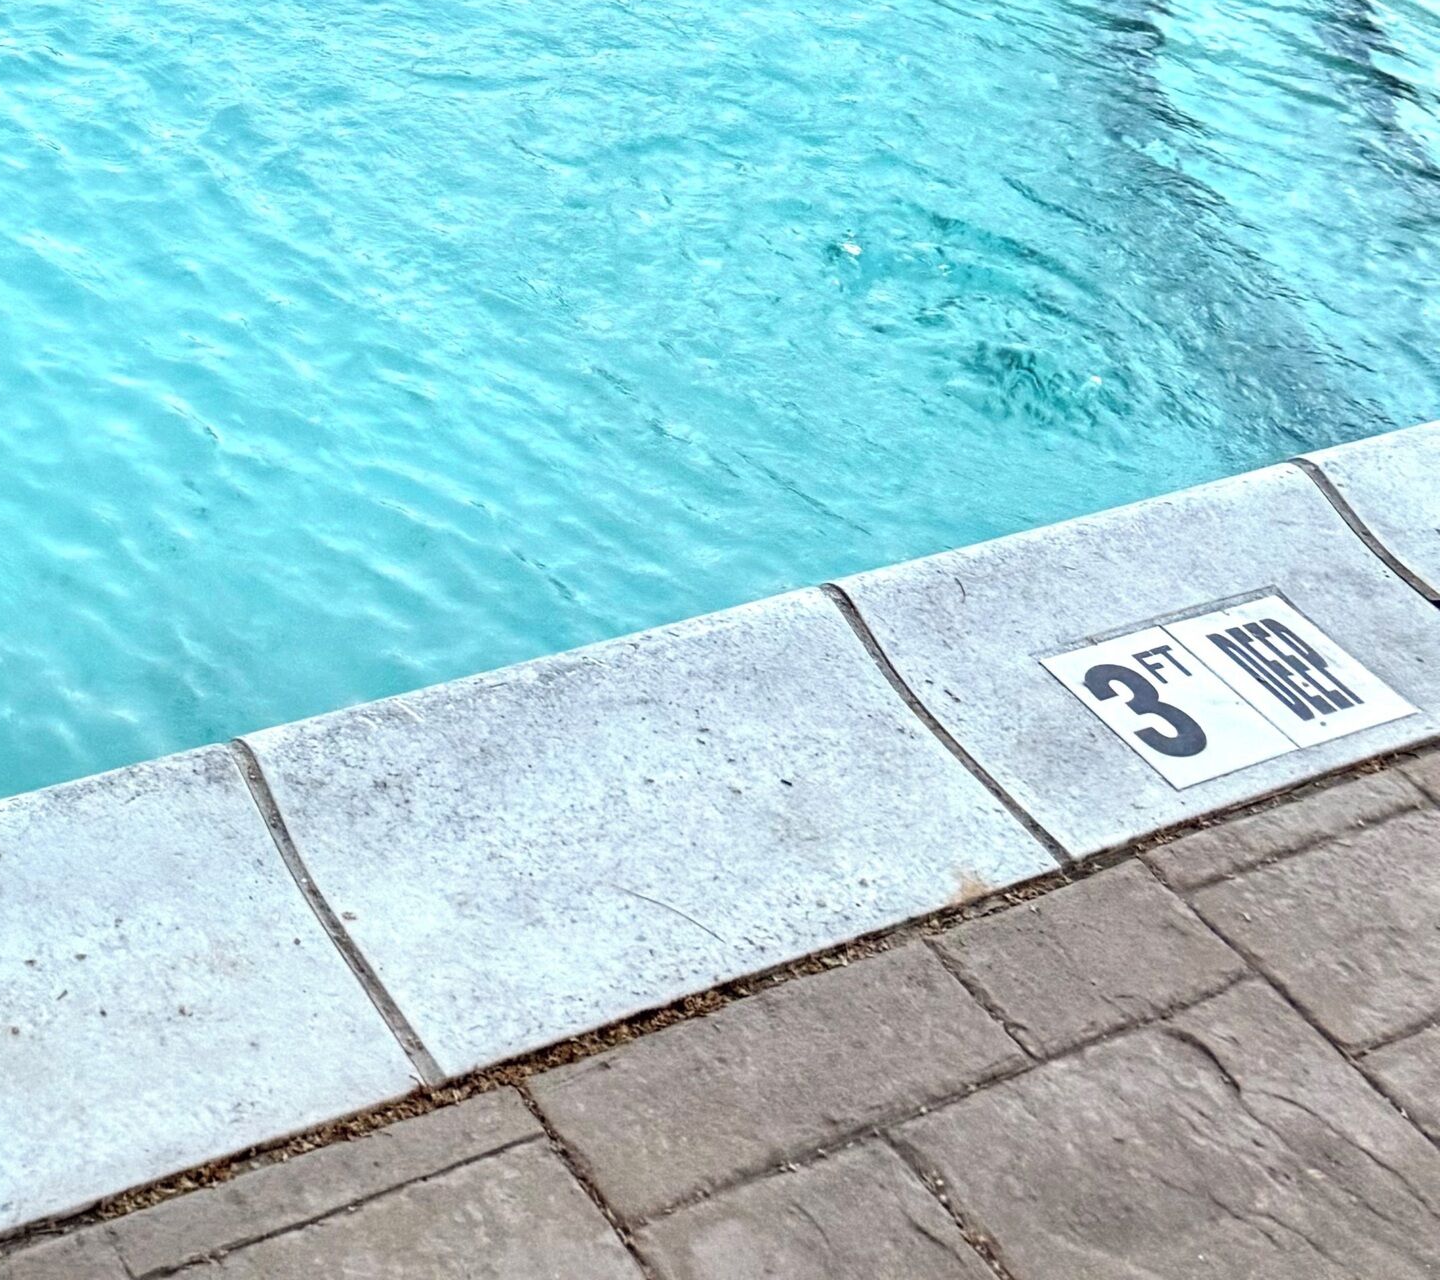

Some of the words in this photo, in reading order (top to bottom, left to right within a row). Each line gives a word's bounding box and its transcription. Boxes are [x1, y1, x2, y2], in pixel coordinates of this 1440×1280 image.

[1084, 664, 1207, 758] 3
[1132, 645, 1192, 684] FT
[1206, 618, 1365, 721] DEEP
